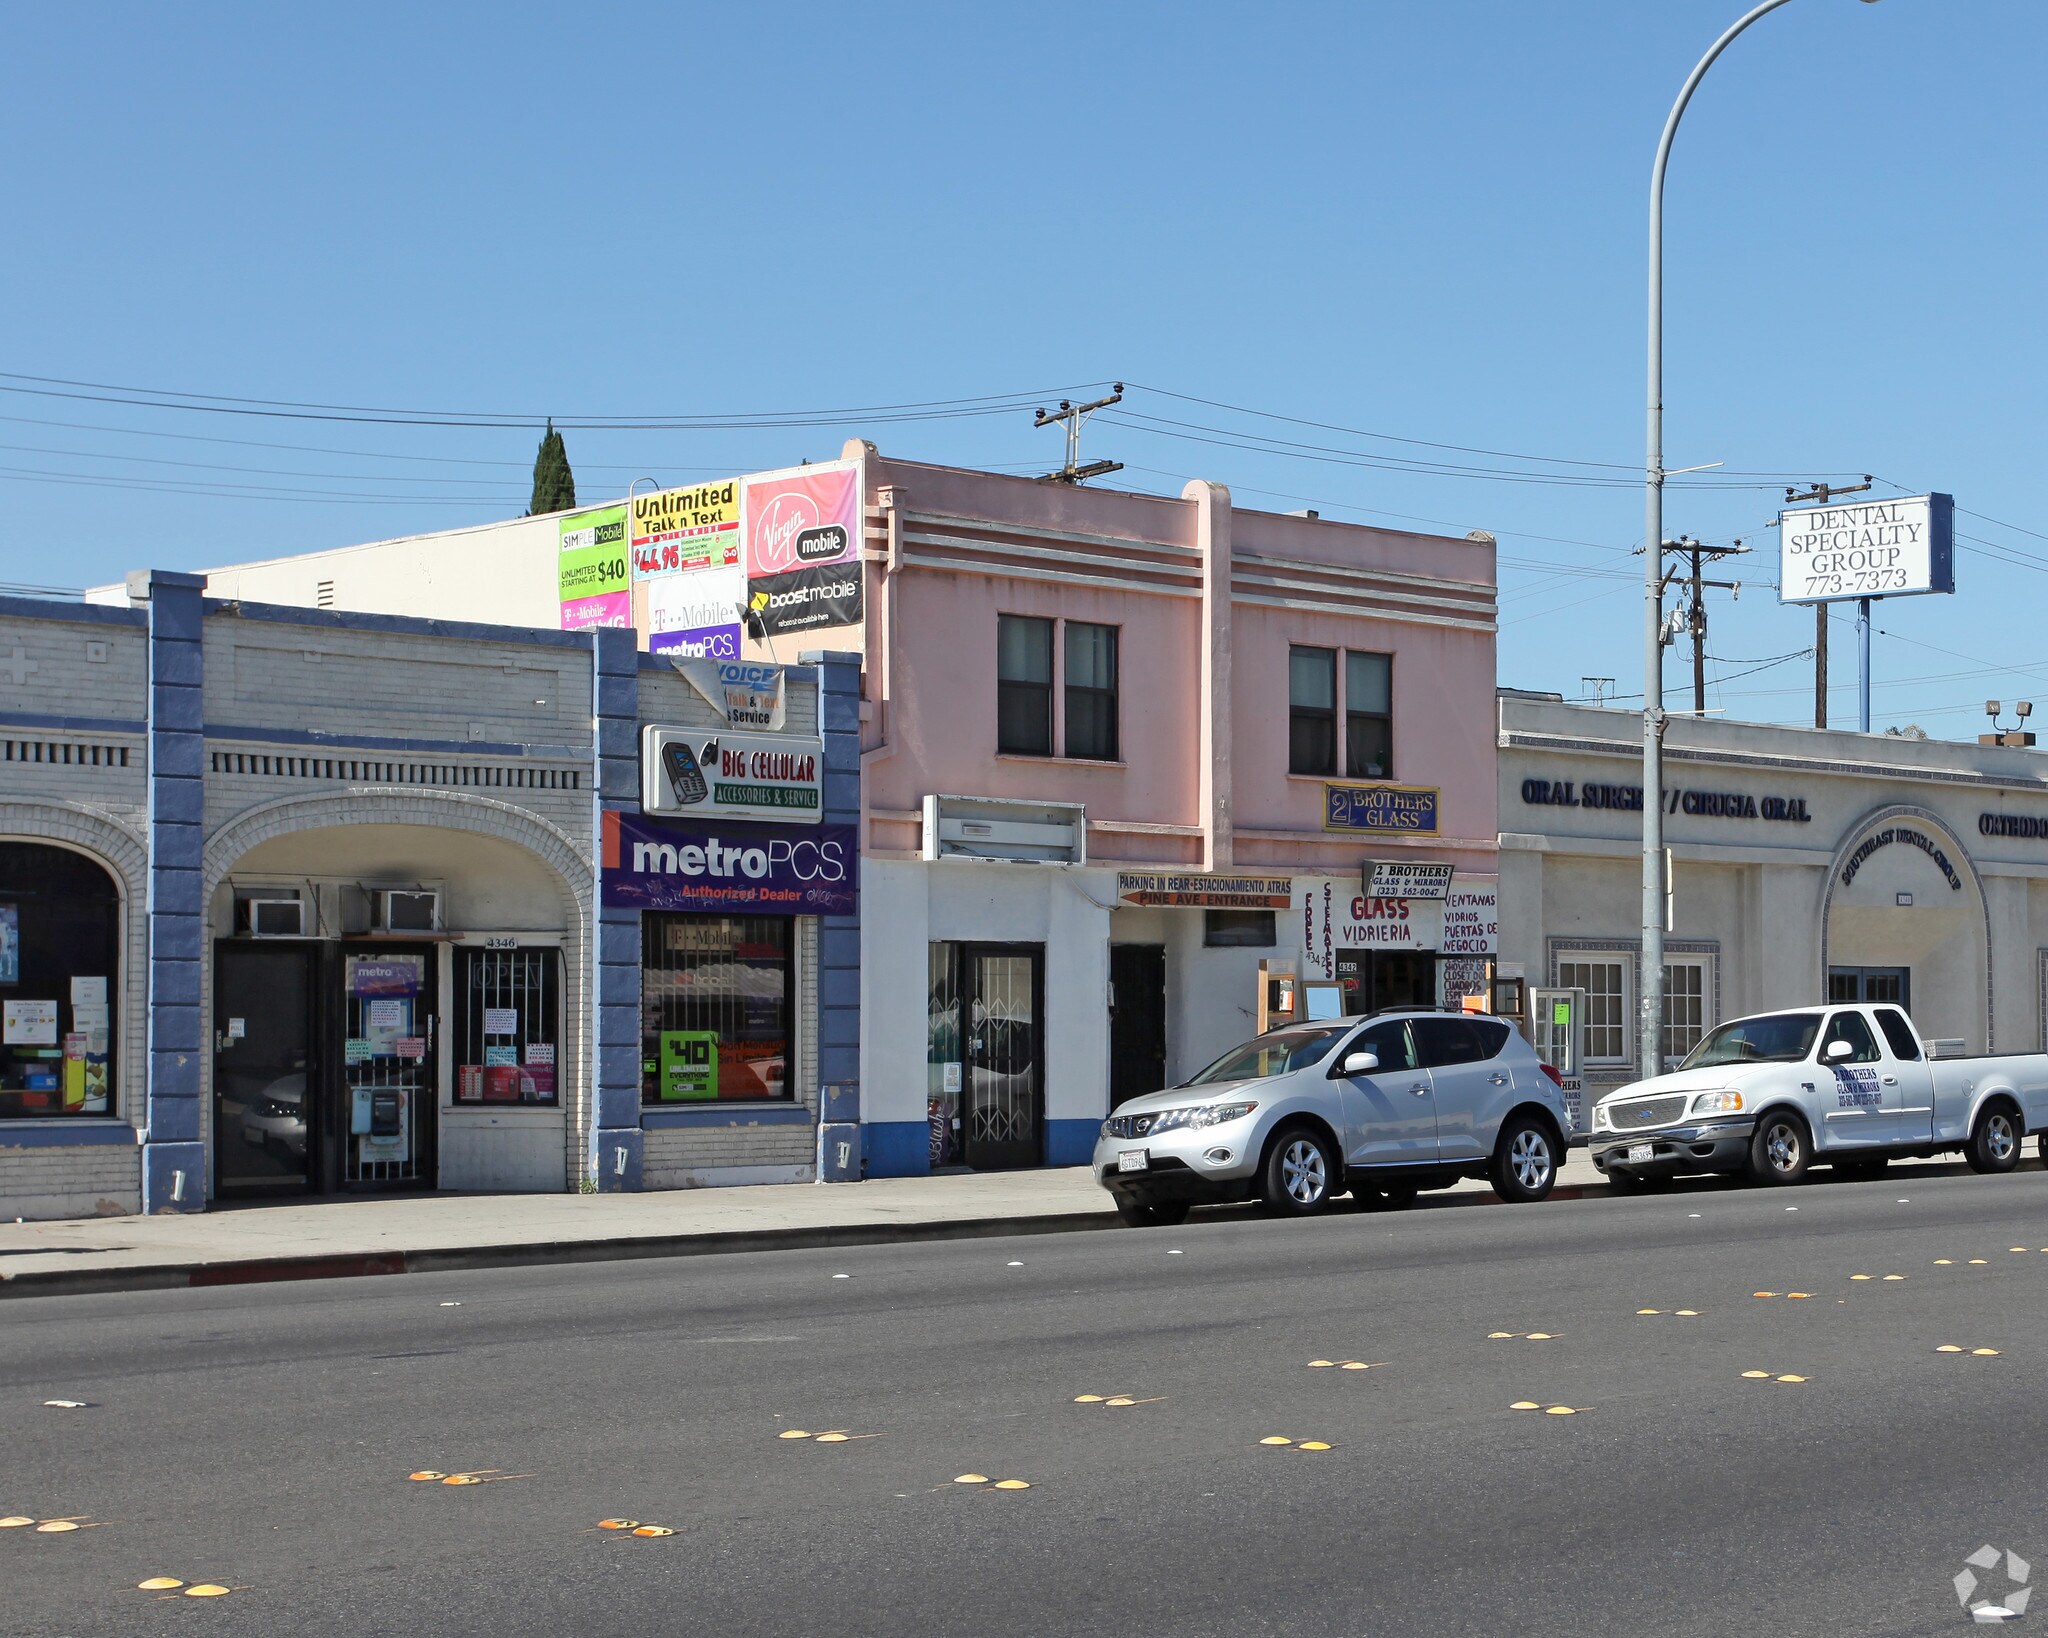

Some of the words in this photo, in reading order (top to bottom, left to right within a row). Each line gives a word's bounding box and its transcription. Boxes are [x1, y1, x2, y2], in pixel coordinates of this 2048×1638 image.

[635, 482, 733, 519] Unlimited
[643, 517, 676, 534] Talk
[680, 517, 687, 528] n
[691, 509, 723, 526] Text
[1809, 503, 1904, 532] DENTAL
[563, 530, 594, 548] SIMPLE
[595, 522, 623, 542] Mobile
[763, 500, 805, 561] Virgin
[1790, 522, 1923, 555] SPECIALTY
[802, 531, 841, 554] mobile
[1811, 547, 1900, 574] GROUP
[561, 565, 596, 579] UNLIMITED
[598, 558, 625, 585] $40
[561, 578, 588, 588] STARTING
[588, 575, 596, 583] AT
[1805, 568, 1907, 596] 773-7373
[750, 696, 757, 708] &
[733, 709, 770, 724] Service
[722, 749, 746, 778] BIG
[750, 751, 815, 782] CELLULAR
[716, 785, 771, 804] ACCESSORIES
[774, 788, 781, 803] &
[783, 788, 817, 807] SERVICE
[1522, 779, 1580, 807] ORAL
[1581, 782, 1668, 812] SURGEY
[1761, 796, 1812, 822] ORAL
[1331, 793, 1348, 821] 2
[1352, 791, 1433, 811] BROTHERS
[1366, 809, 1419, 828] GLASS
[633, 838, 843, 881] metroPCS
[1842, 829, 1895, 887] SOUTHEAST
[1896, 829, 1935, 857] DENTAL
[1933, 850, 1961, 890] GROUP
[1375, 865, 1384, 876] 2
[1388, 866, 1449, 877] BROTHERS
[1119, 875, 1154, 890] PARKING
[1157, 877, 1166, 890] IN
[1266, 879, 1291, 894] ATRAS
[1373, 877, 1401, 886] GLASS
[1404, 878, 1411, 886] &
[1413, 878, 1448, 887] MIRRORS
[682, 884, 755, 901] Authorized
[759, 887, 802, 901] Dealer
[1139, 892, 1170, 904] PINE
[1176, 893, 1204, 905] AVE.
[1207, 893, 1271, 907] ENTRANCE
[1377, 887, 1399, 897] (323)
[1402, 888, 1440, 897] 562-0047
[1446, 894, 1496, 908] VENTANAS
[1350, 896, 1410, 921] GLASS
[1444, 912, 1479, 923] VIDRIOS
[1305, 892, 1313, 951] FREE
[1444, 924, 1484, 939] PUERTAS
[1487, 922, 1497, 935] DE
[487, 937, 515, 948] 4346
[1343, 924, 1412, 942] VIDRIERIA
[1443, 939, 1488, 953] NEGOCIO
[1306, 951, 1326, 967] 4342
[1339, 963, 1356, 972] 4342
[477, 965, 540, 986] OPEN
[669, 1040, 709, 1064] $40
[1840, 1068, 1877, 1081] BROTHERS
[1562, 1080, 1581, 1090] HERS
[1836, 1082, 1853, 1094] GLASS
